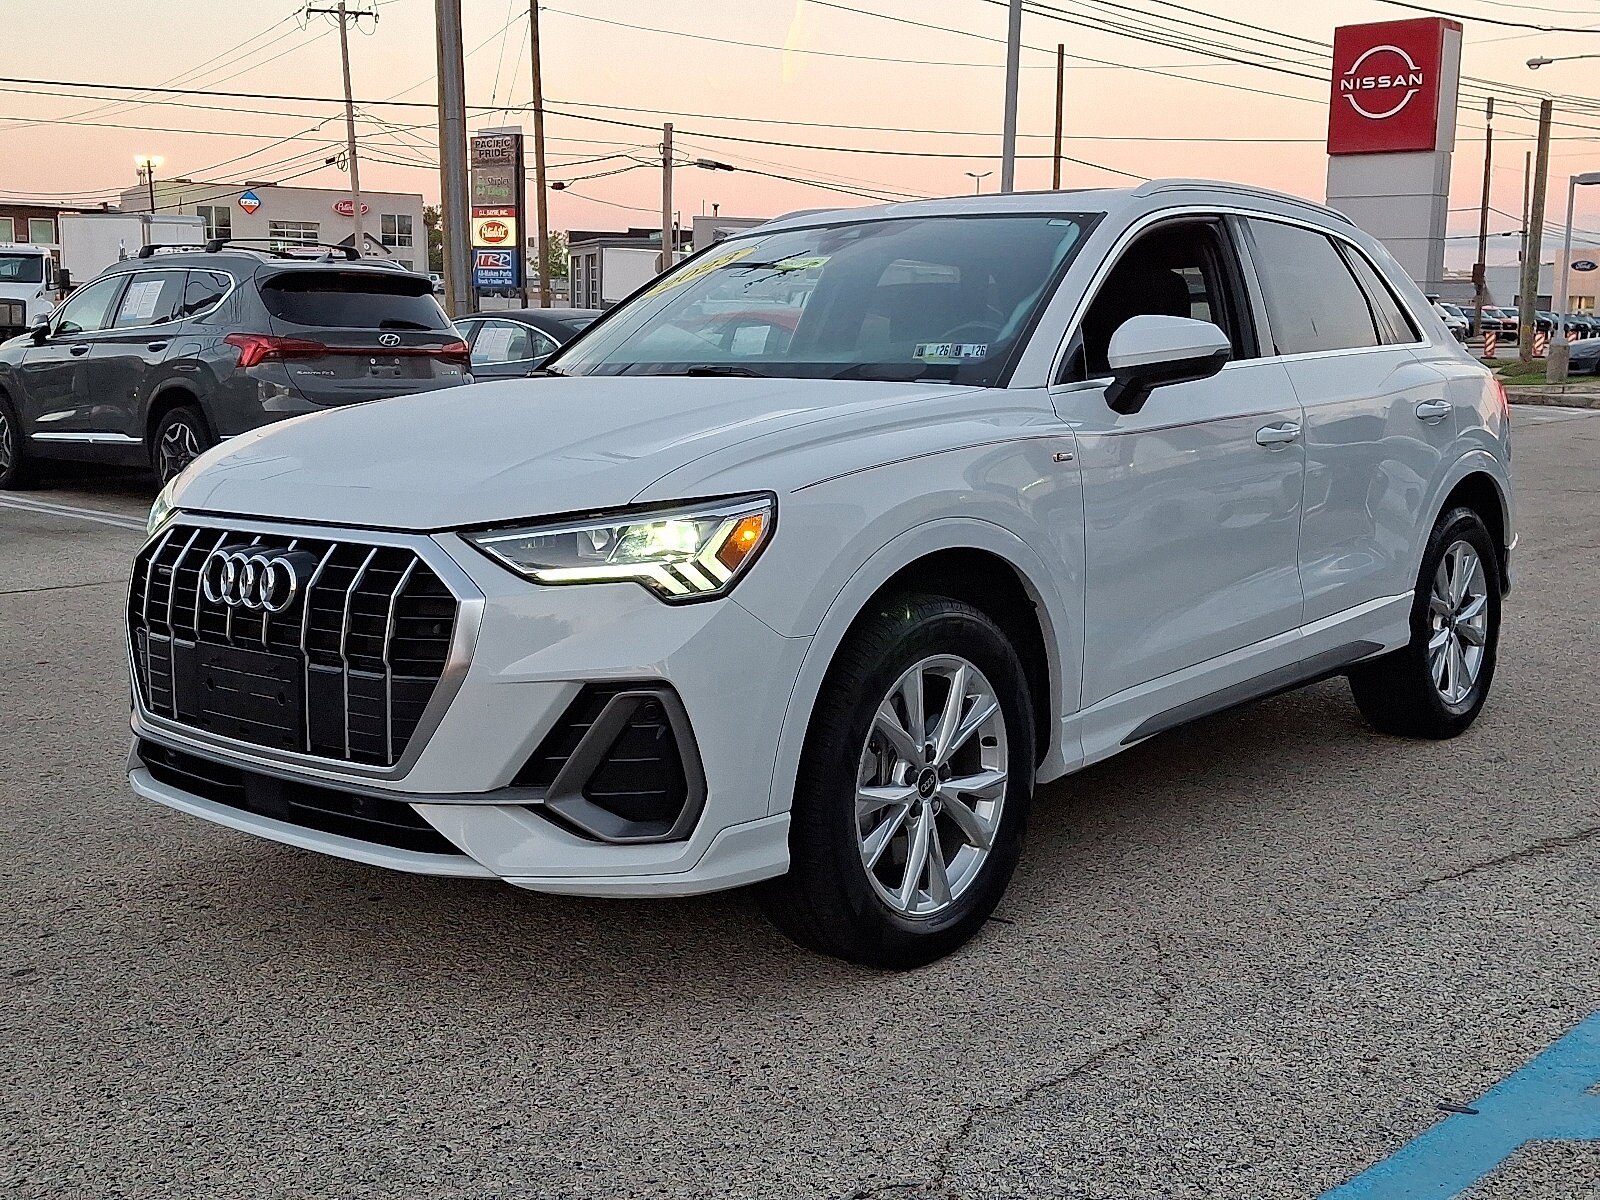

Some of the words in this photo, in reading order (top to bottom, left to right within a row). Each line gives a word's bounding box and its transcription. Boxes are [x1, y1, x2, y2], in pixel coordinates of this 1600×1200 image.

[1340, 73, 1423, 91] NISSAN
[475, 139, 511, 149] PACIFIC
[479, 148, 507, 158] PRIDE
[479, 253, 511, 267] TRP
